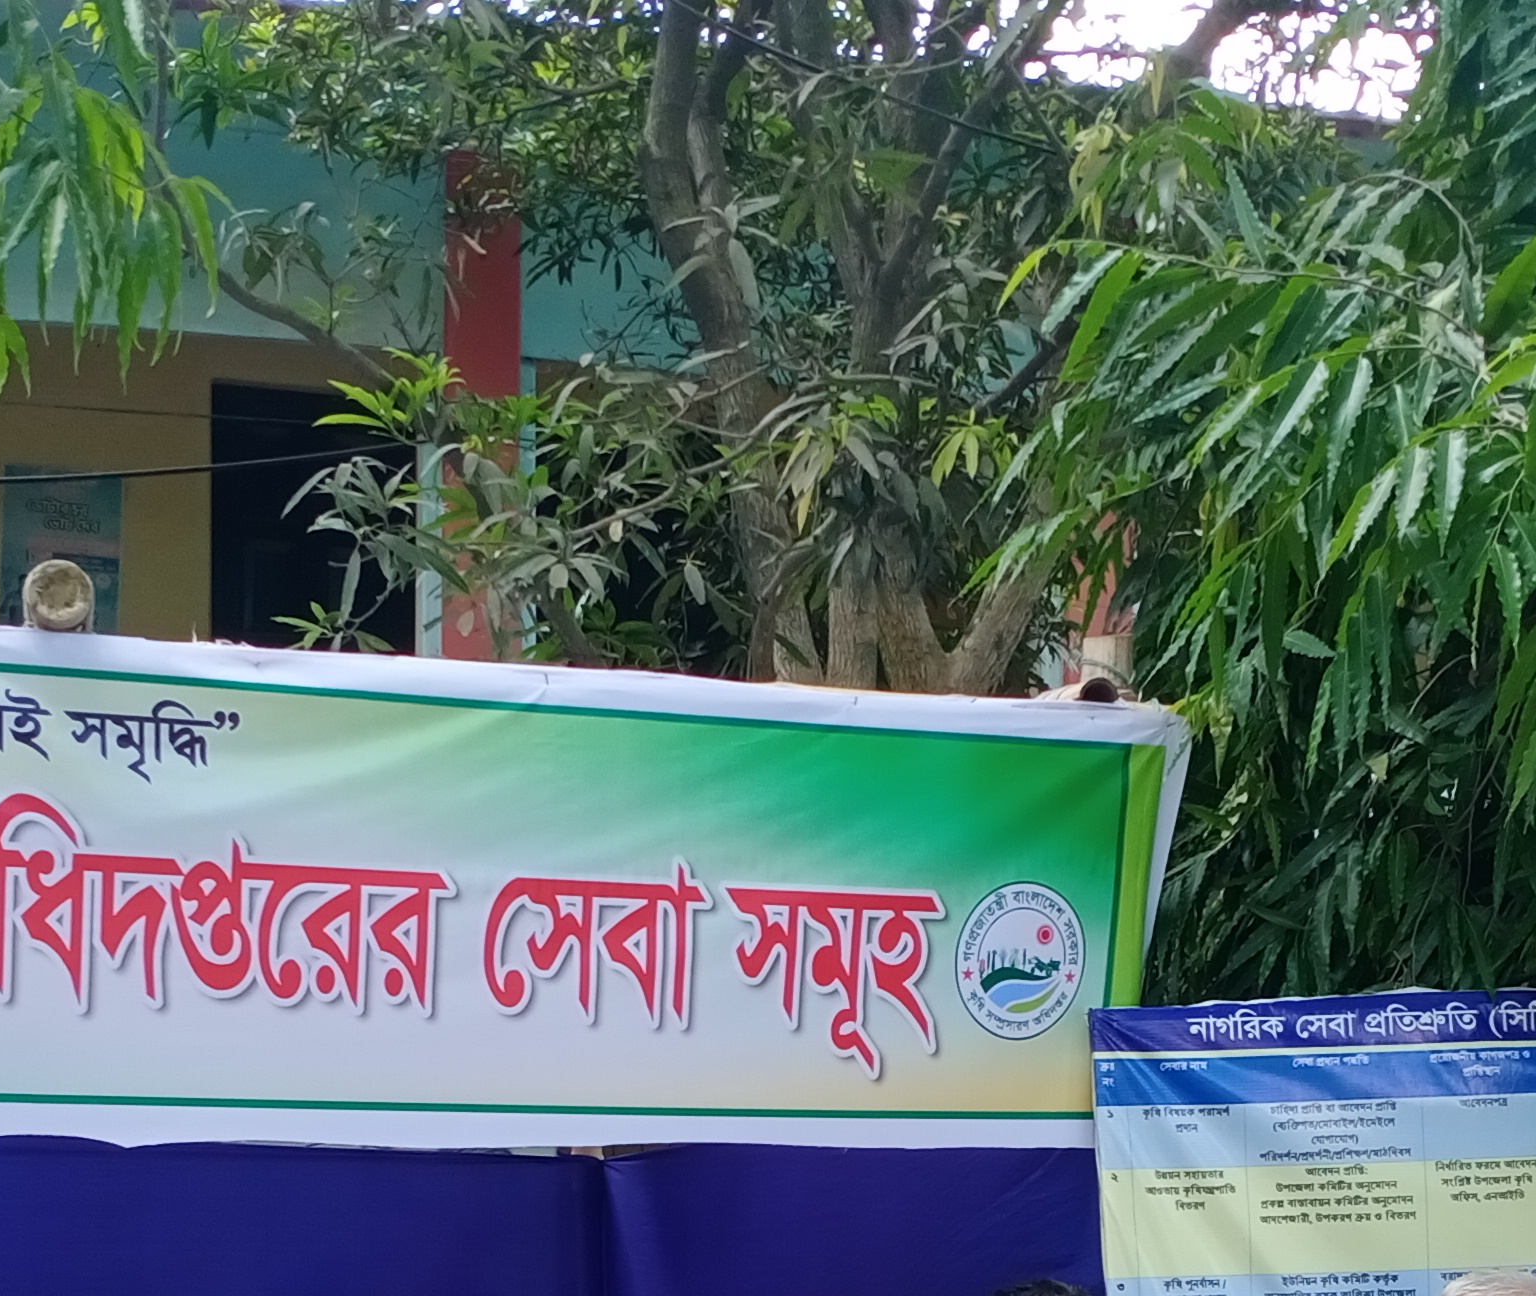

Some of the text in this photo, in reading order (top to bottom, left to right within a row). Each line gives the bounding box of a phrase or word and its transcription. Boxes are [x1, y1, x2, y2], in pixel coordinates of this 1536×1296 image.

[72, 708, 241, 782] সমৃদ্ধি”
[488, 859, 712, 1027] সেবা
[726, 883, 945, 1077] সমূহ
[1187, 1009, 1286, 1042] নাগরিক
[1296, 1011, 1357, 1040] সেবা
[1365, 1003, 1479, 1036] প্রতিশ্রুতি
